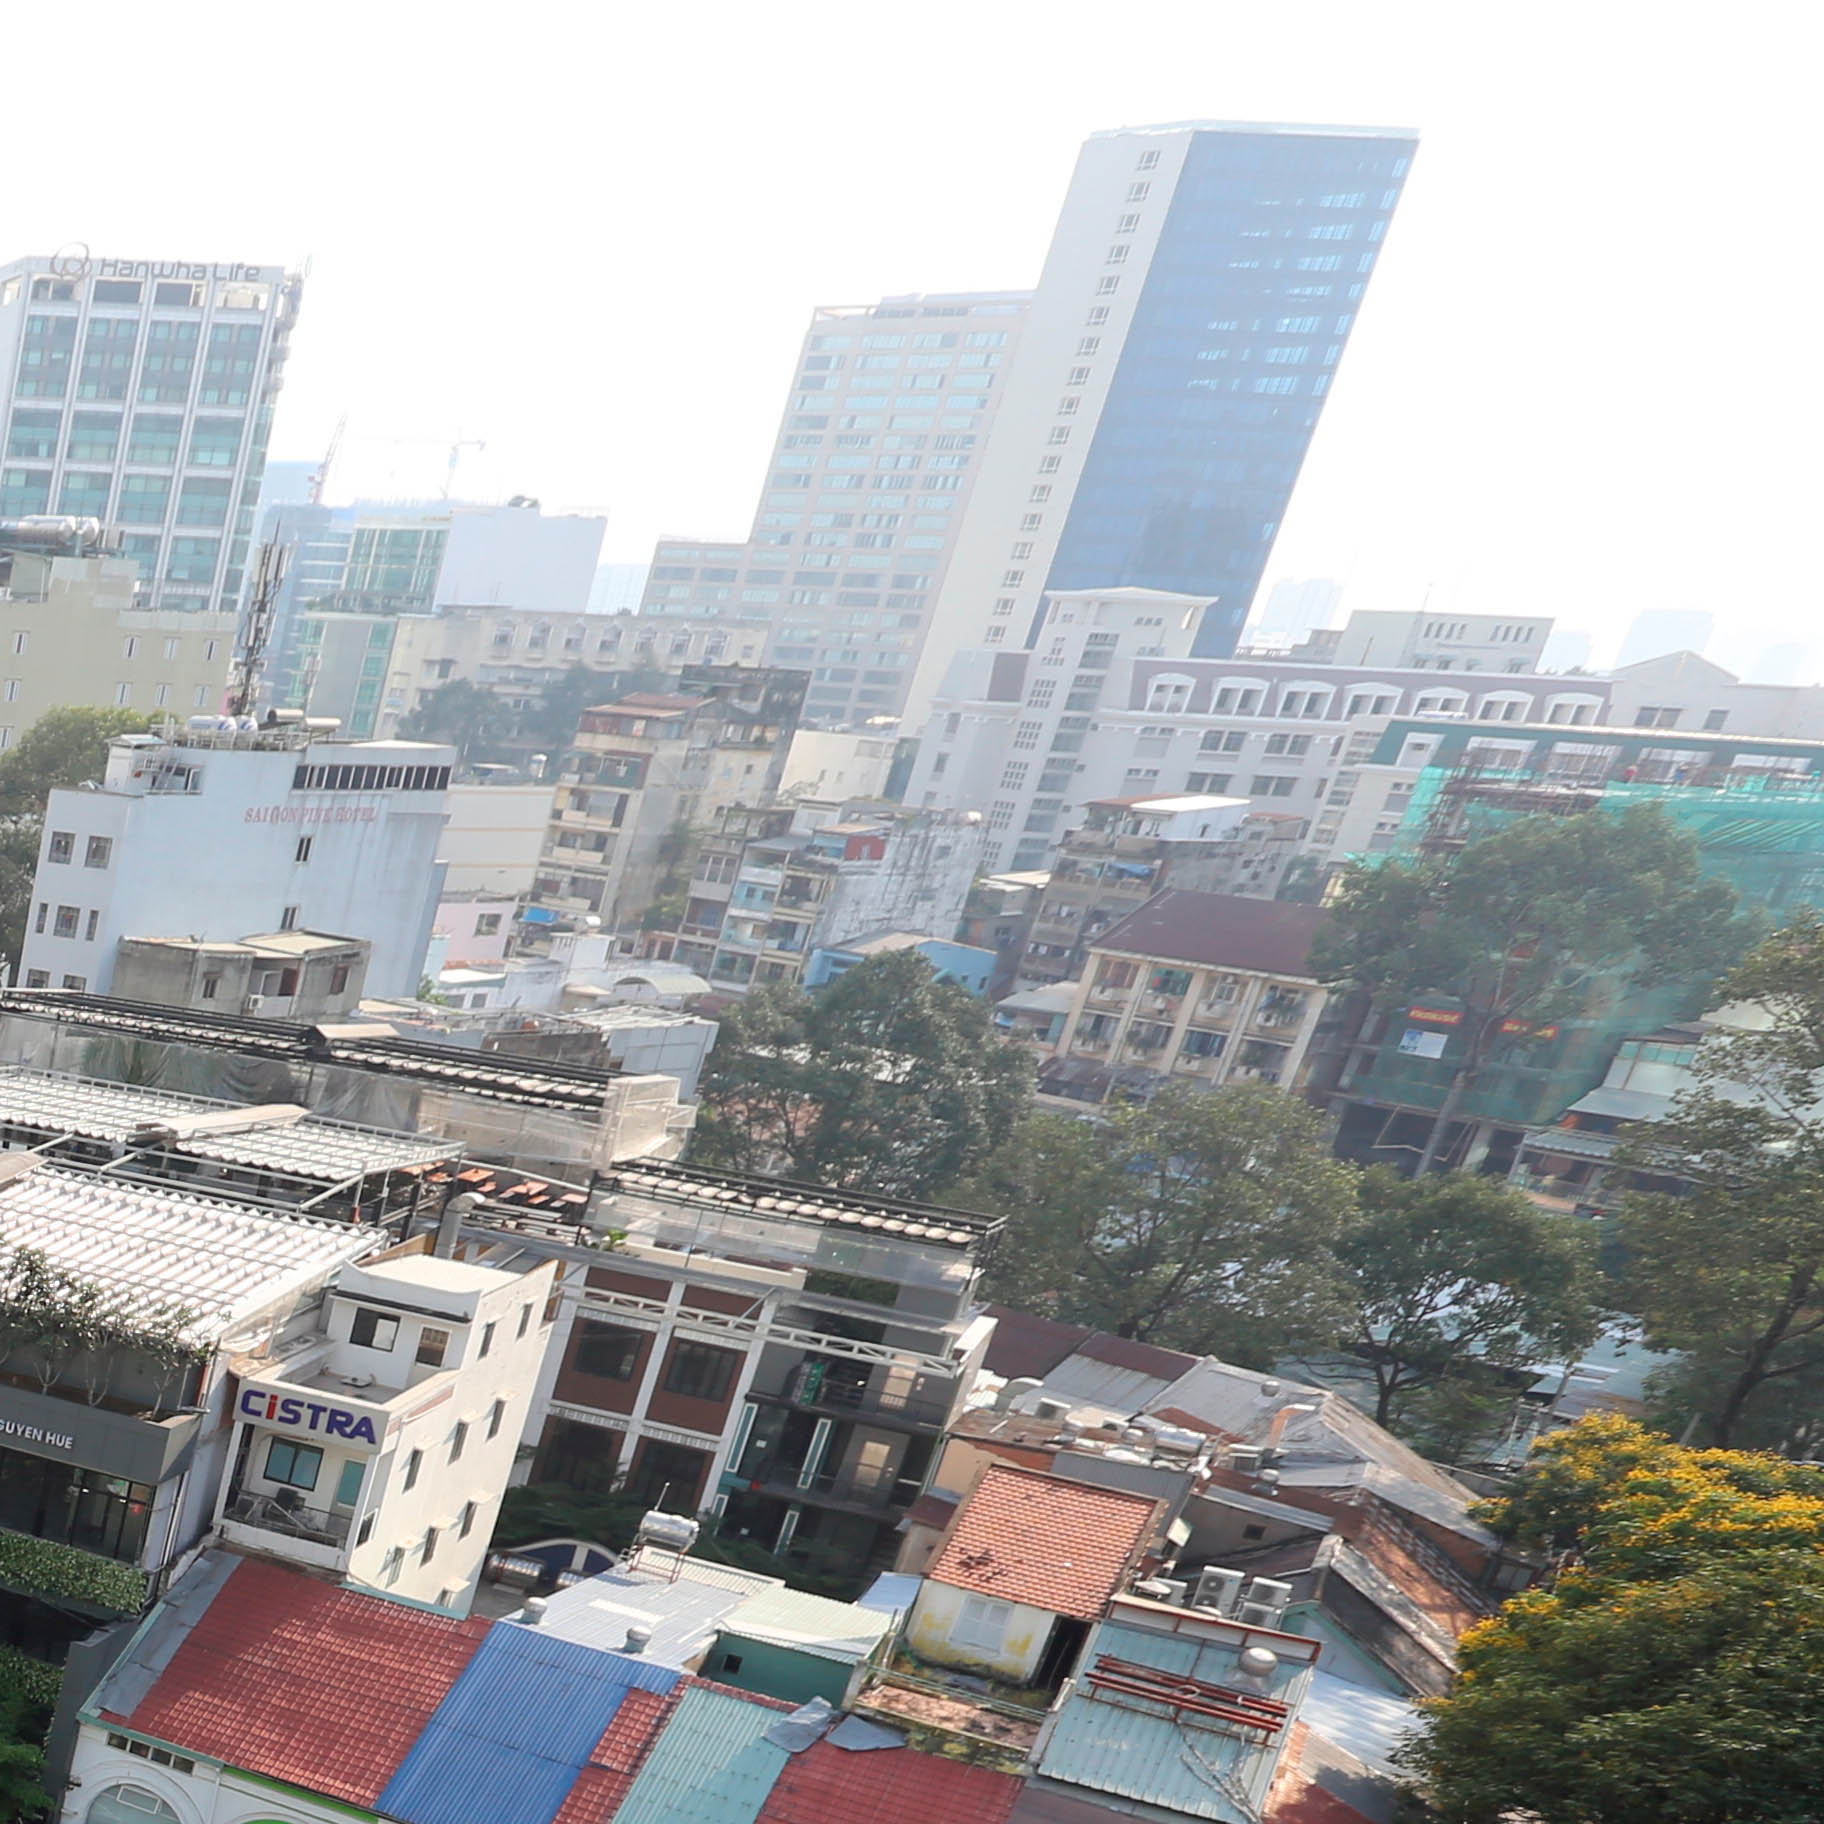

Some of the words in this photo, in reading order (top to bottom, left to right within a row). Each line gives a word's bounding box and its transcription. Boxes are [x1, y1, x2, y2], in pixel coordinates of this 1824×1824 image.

[101, 258, 207, 280] Hanwha
[212, 262, 261, 282] Life
[45, 1429, 74, 1449] HUE
